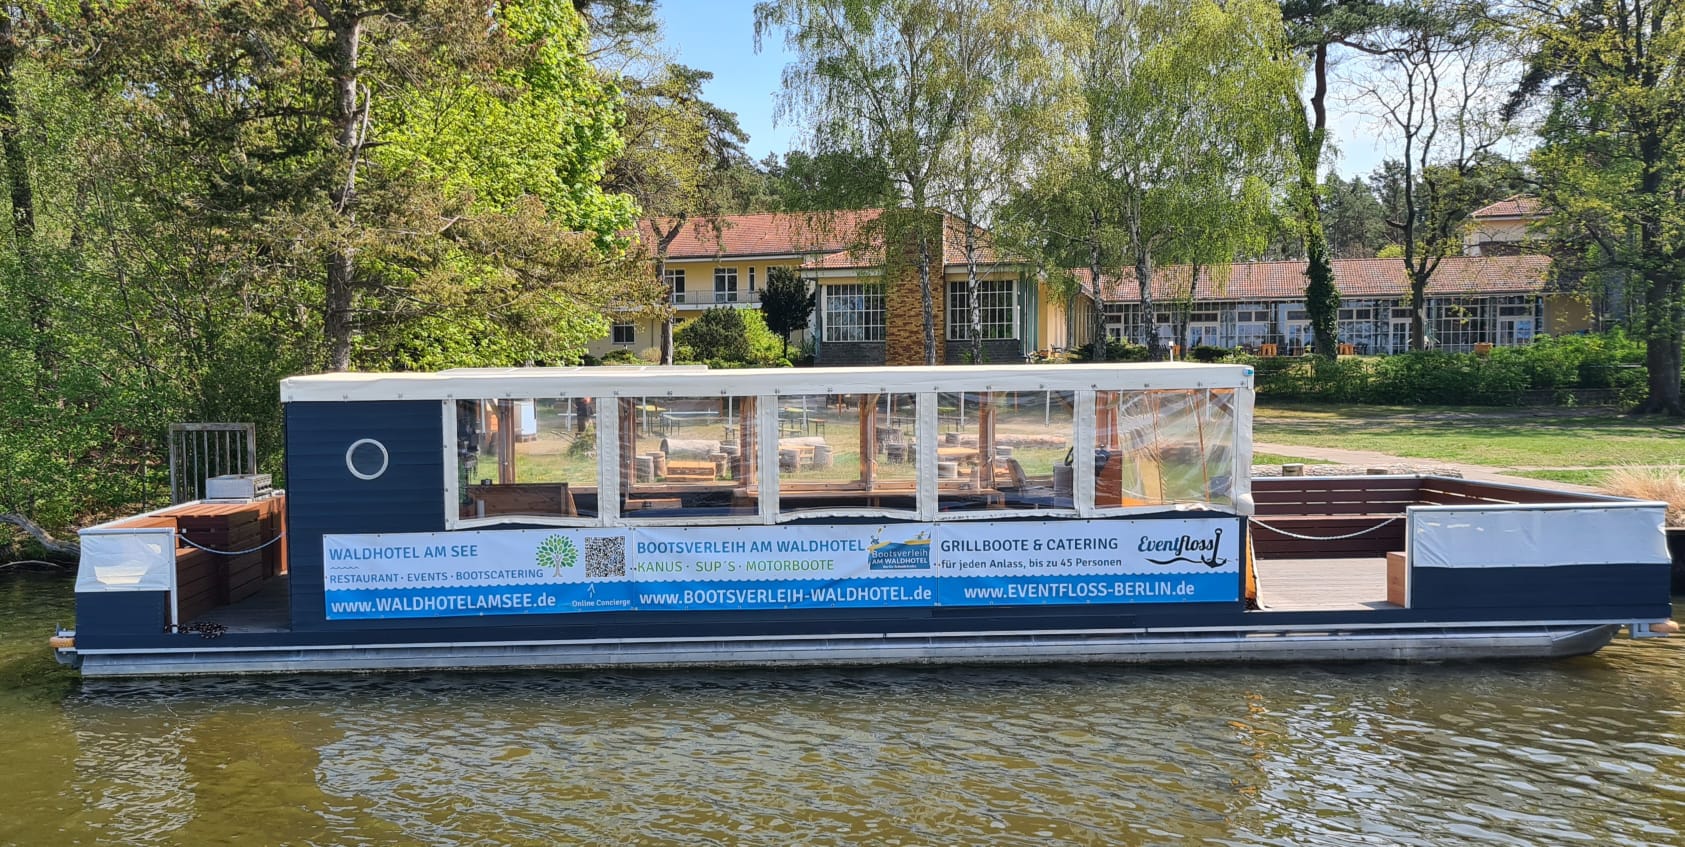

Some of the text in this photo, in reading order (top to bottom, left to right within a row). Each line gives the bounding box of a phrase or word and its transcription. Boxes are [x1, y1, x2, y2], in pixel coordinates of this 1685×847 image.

[637, 539, 865, 554] BOOTSVERLEIH AM WALDHOTEL
[941, 537, 1118, 552] GRILLBOOTE & CATERING
[1138, 534, 1214, 556] Eventfloss
[329, 545, 478, 561] WALDHOTEL AM SEE
[872, 549, 928, 558] Bootsverleih
[637, 561, 683, 573] KANUS
[746, 560, 834, 572] MOTORBOOTE
[941, 557, 1122, 570] für jeden Anlass, bis zu 45 Personen
[329, 569, 544, 584] RESTAURANT EVENTS BOOTSCATERING
[640, 585, 932, 605] www.BOOTSVERLEIH-WALDHOTEL.de
[964, 581, 1195, 599] www.EVENTFLOSS-BERLIN.de
[331, 592, 556, 613] www.WALDHOTELAMSEE.de
[572, 599, 631, 607] Online Concierge
